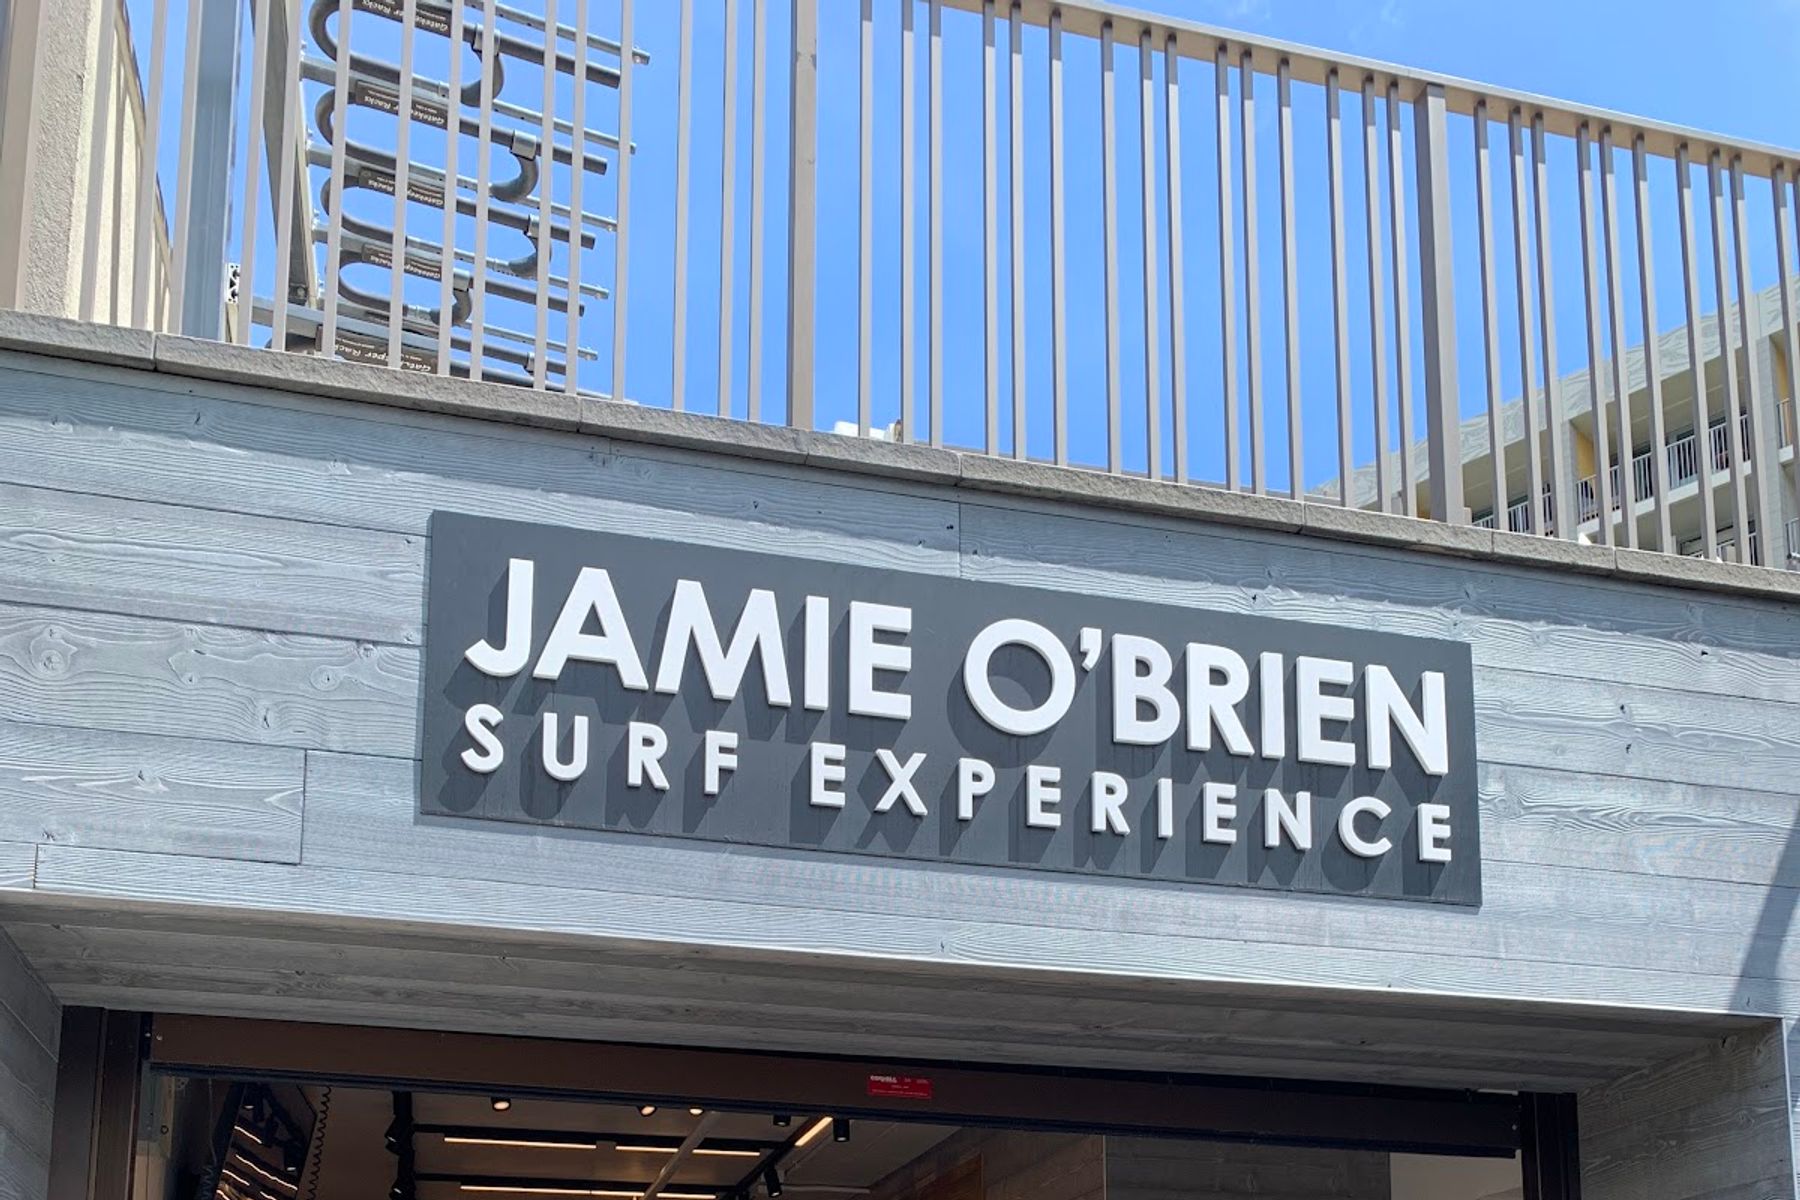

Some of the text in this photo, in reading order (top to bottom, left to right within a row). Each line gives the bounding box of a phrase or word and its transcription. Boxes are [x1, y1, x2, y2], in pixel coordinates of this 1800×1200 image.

[464, 557, 1449, 776] JAMIE O'BRIEN
[460, 703, 1452, 862] SURF EXPERIENCE
